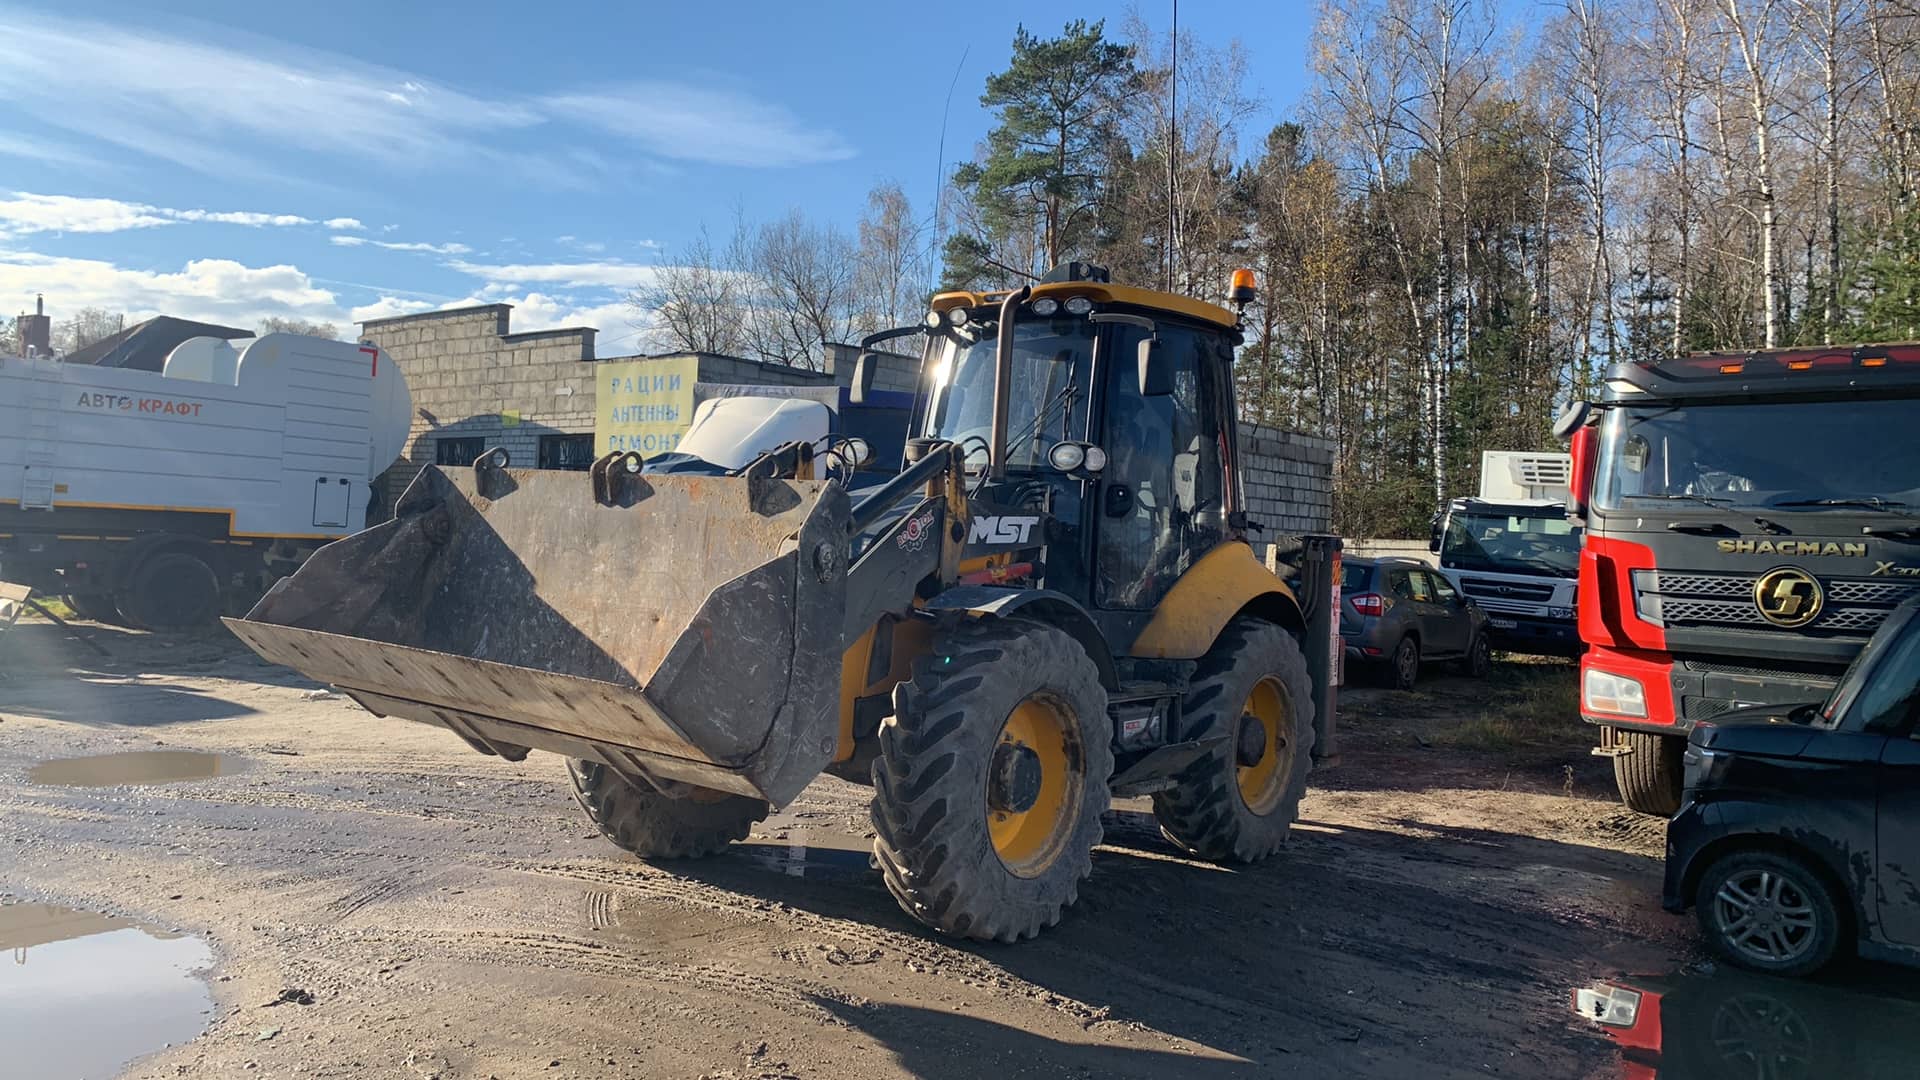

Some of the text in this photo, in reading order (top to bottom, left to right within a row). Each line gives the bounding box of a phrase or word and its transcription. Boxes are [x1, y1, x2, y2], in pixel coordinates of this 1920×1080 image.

[611, 374, 681, 395] РАЦИИ
[78, 391, 203, 417] АВТО КРАФТ
[611, 403, 680, 423] АНТЕННЫ
[608, 433, 682, 452] РЕМОНТ
[967, 516, 1040, 545] MST
[1717, 539, 1868, 557] SHACMAN
